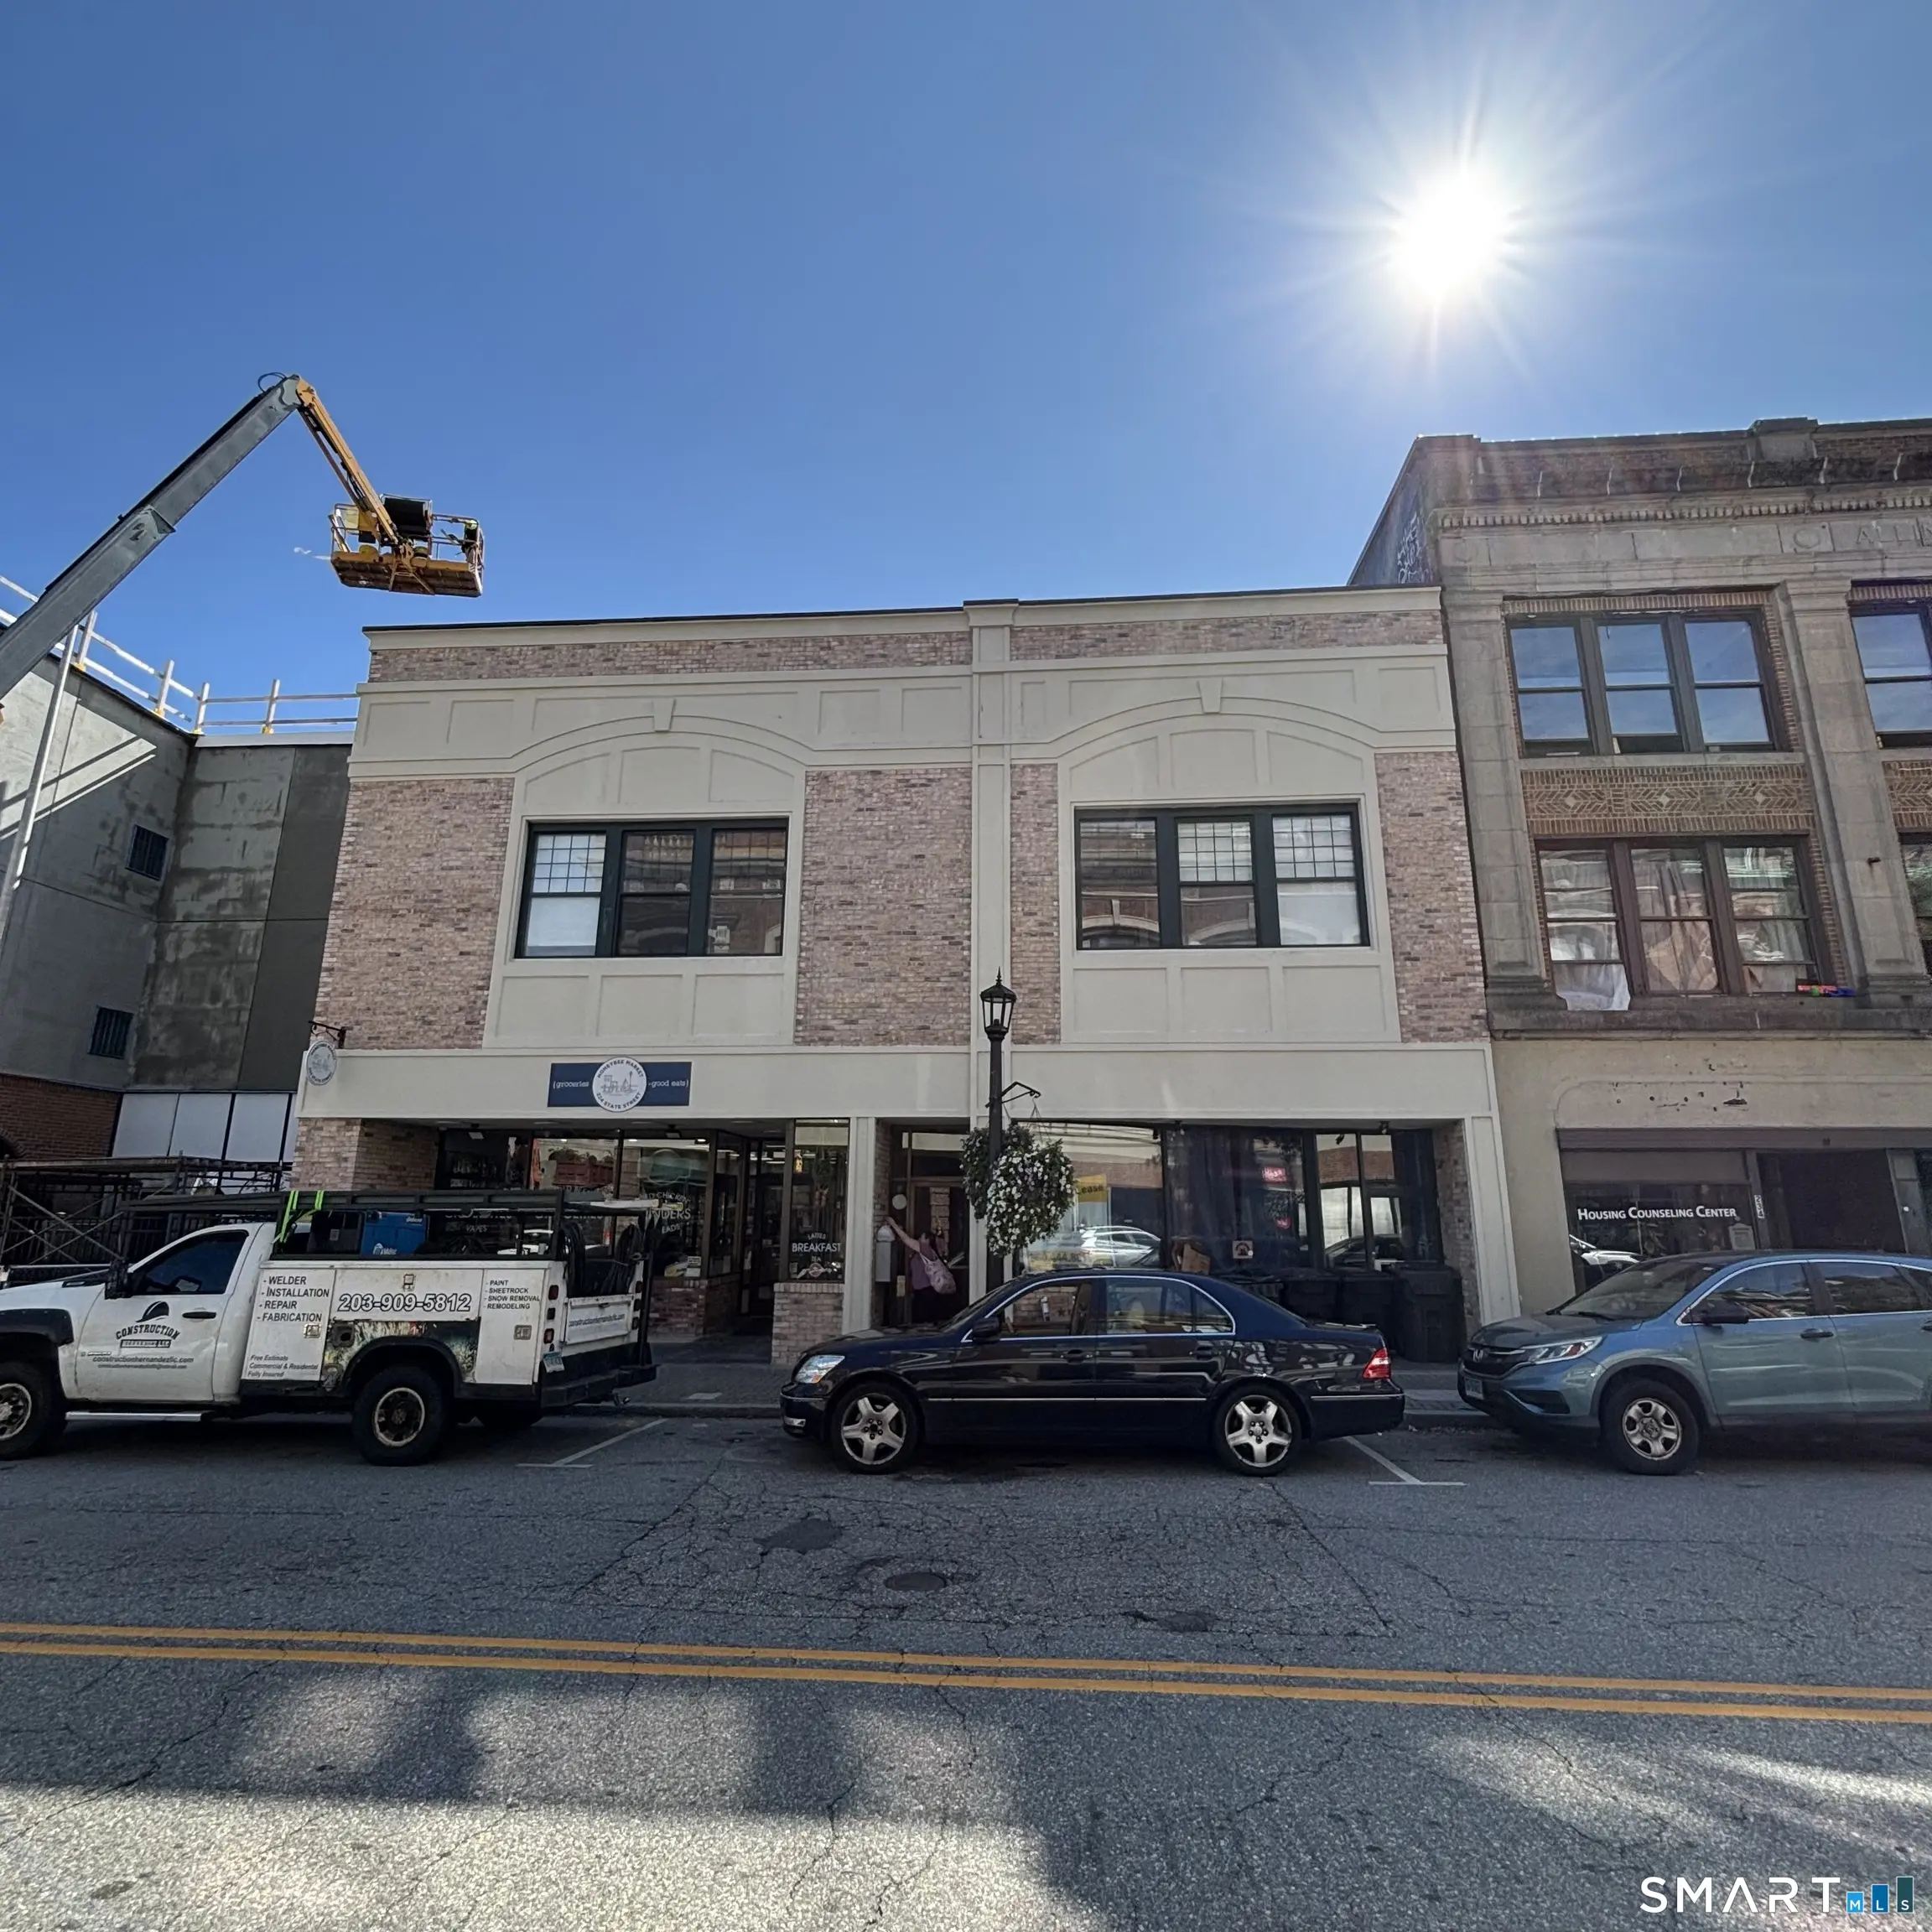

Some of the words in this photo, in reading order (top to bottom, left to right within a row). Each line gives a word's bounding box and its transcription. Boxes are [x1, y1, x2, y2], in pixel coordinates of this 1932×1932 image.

[626, 1060, 644, 1078] MARKET
[604, 1100, 621, 1109] STATE
[622, 1092, 641, 1109] STREET
[1578, 1208, 1626, 1220] HOUSING
[1628, 1207, 1694, 1218] COUNSELING
[1696, 1205, 1737, 1218] CENTER
[792, 1242, 841, 1252] BREAKFAST
[268, 1275, 307, 1285] WELDER
[266, 1286, 330, 1298] INSTALLATION
[264, 1300, 298, 1309] REPAIR
[337, 1293, 472, 1312] 203-909-5812
[262, 1312, 323, 1322] FABRICATION
[116, 1323, 181, 1341] CONSTRUCTION
